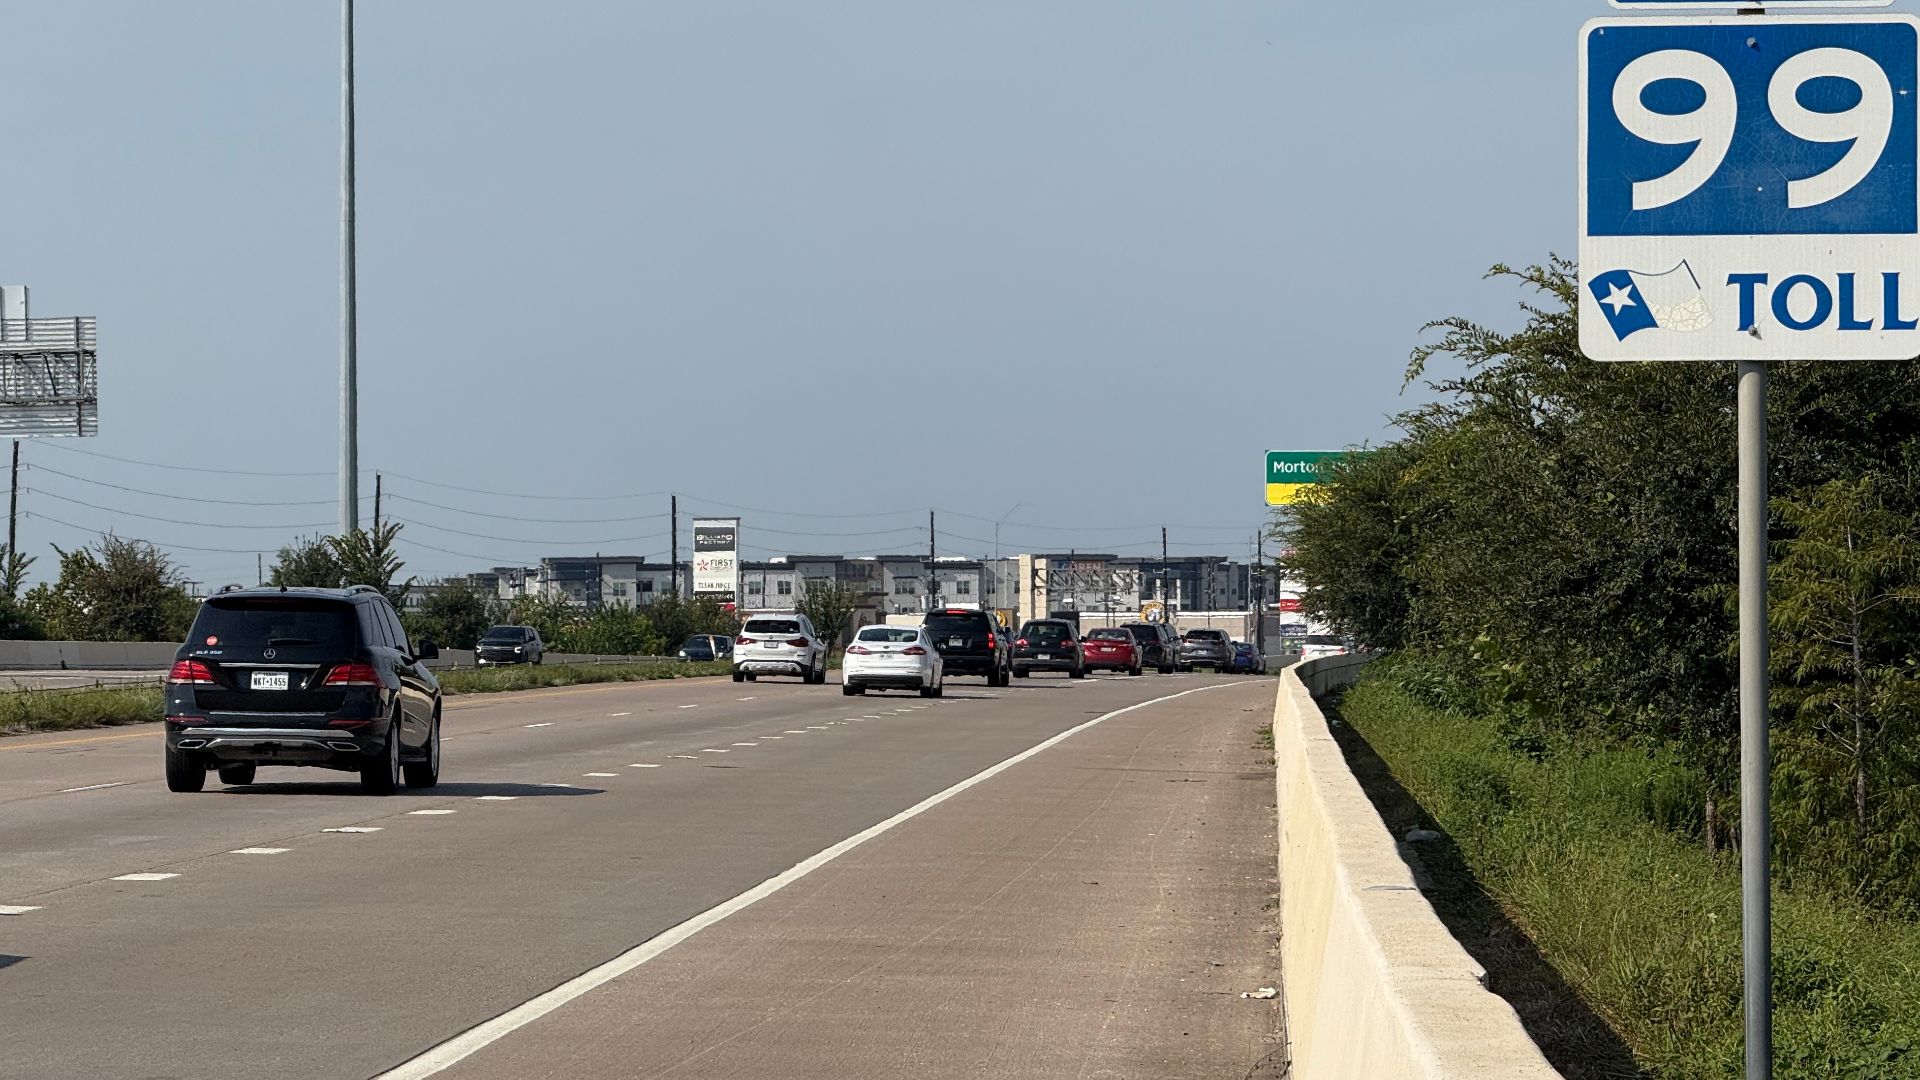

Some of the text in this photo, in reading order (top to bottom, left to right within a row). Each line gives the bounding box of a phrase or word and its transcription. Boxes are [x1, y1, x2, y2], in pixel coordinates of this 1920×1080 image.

[1612, 47, 1894, 210] 99
[1726, 272, 1919, 331] TOLL
[710, 559, 734, 567] FIRST
